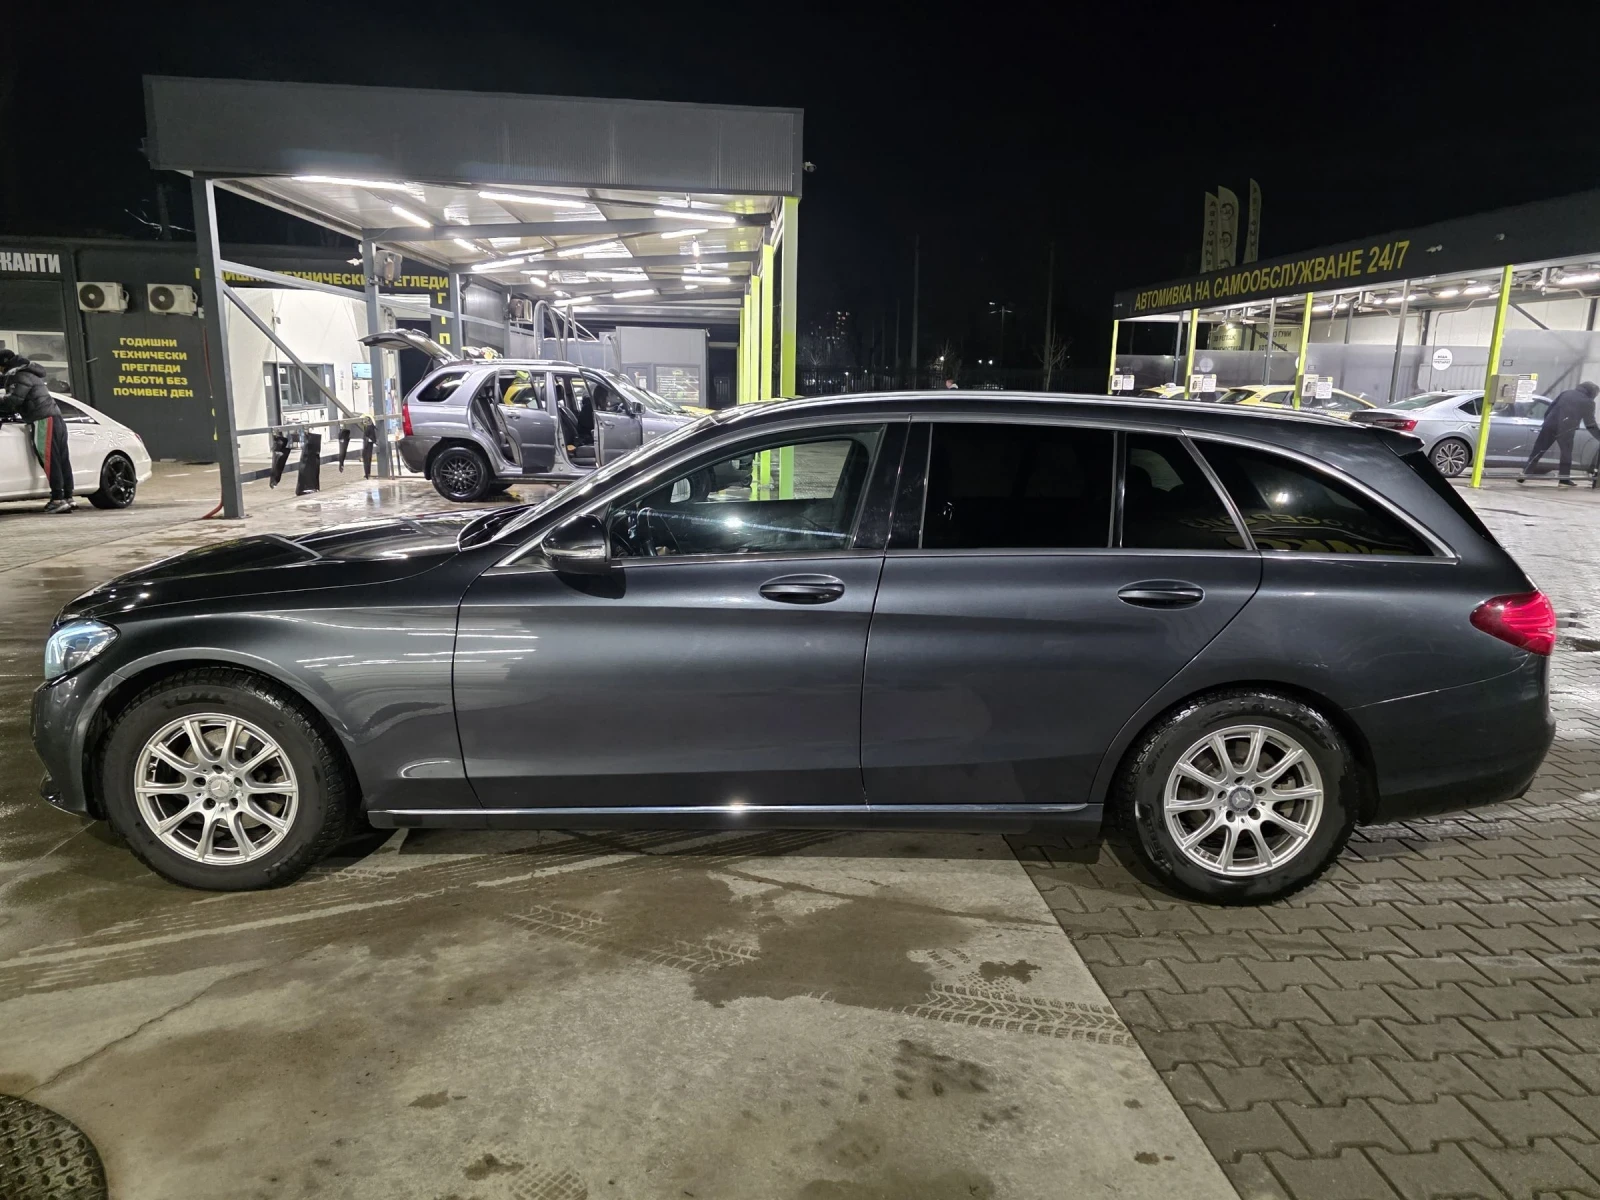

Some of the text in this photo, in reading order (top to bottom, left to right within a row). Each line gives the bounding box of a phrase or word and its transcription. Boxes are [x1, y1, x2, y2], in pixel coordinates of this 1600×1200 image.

[1134, 240, 1410, 311] АВТОМИВКА НА САМООБСЛУЖВАНЕ 24/7
[119, 337, 178, 347] ГОДИШНИ
[112, 350, 187, 360] ТЕХНИЧЕСКИ
[121, 363, 181, 374] ПРЕГЛЕДИ
[118, 375, 188, 385] РАБОТИ БЕЗ
[113, 387, 194, 398] ПОЧИВЕН ДЕН
